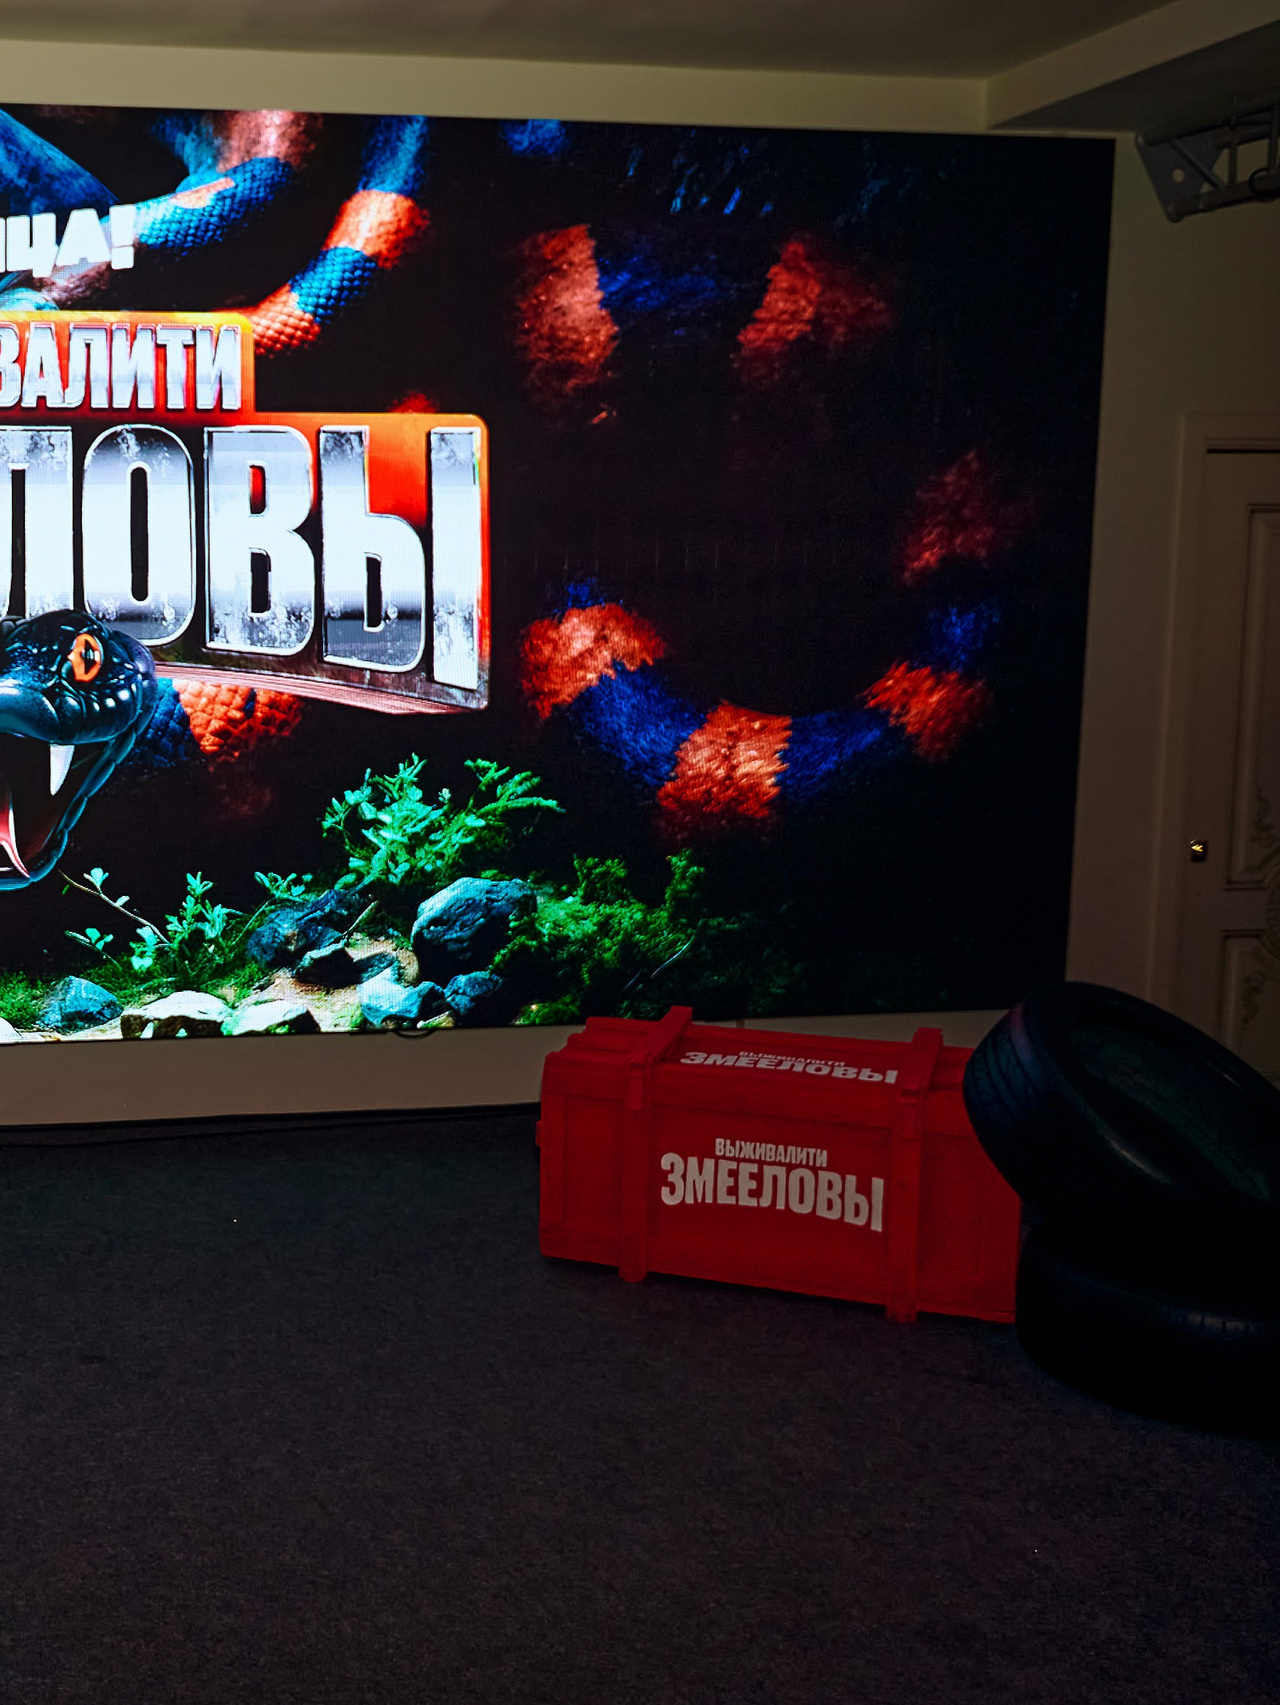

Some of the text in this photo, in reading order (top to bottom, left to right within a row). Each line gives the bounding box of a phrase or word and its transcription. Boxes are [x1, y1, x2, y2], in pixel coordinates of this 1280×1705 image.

[680, 1051, 899, 1085] ЗМЕЕЛОВЫ
[715, 1138, 828, 1167] ВЫЖИВАЛИТИ
[660, 1152, 885, 1232] ЗМЕЕЛОВЫ
